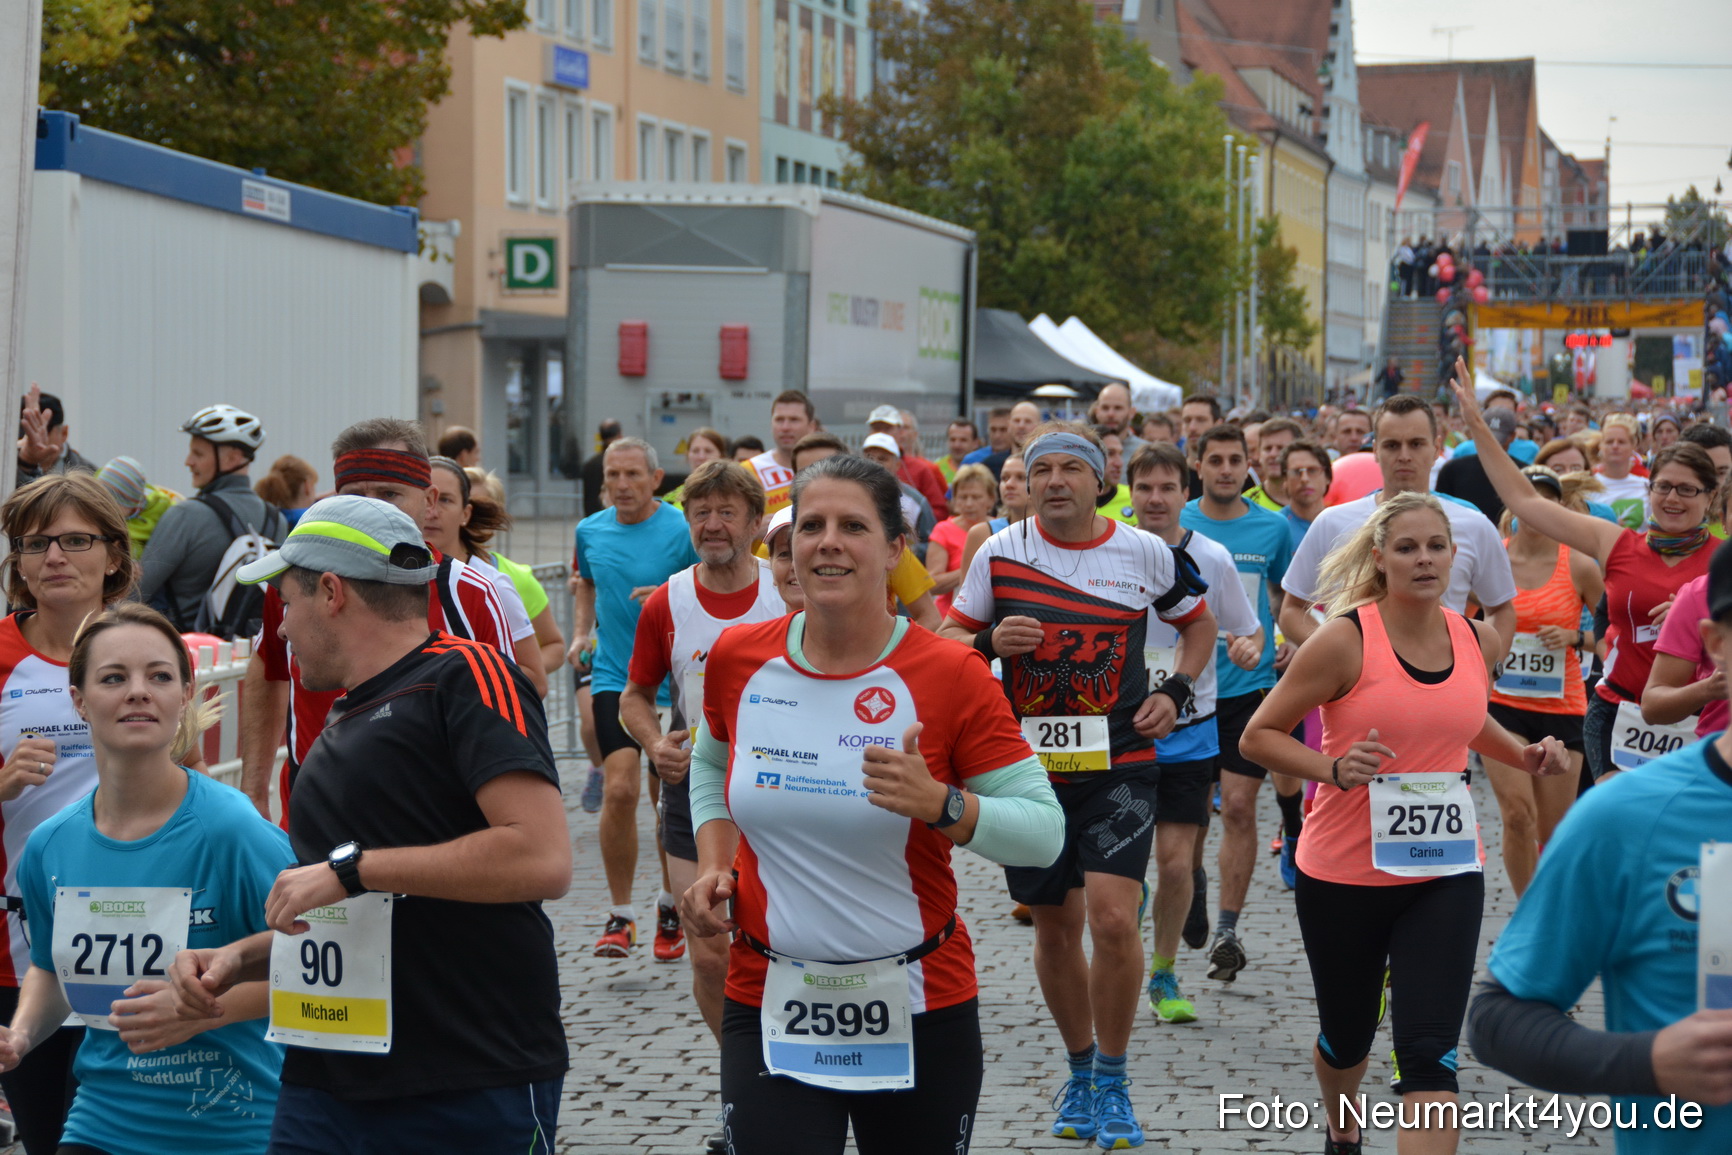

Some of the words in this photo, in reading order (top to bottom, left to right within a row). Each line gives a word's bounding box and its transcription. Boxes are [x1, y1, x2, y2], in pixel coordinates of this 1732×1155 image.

[513, 244, 551, 284] D
[1234, 553, 1266, 563] BOCK
[1088, 579, 1138, 591] NEUMARKT
[1505, 652, 1555, 673] 2159
[1519, 678, 1537, 687] Julia
[838, 734, 895, 750] KOPPE
[1038, 722, 1082, 747] 281
[1623, 727, 1684, 756] 2040
[752, 746, 790, 758] MICHAEL
[792, 750, 819, 760] KLEIN
[785, 775, 847, 787] Raiffeisenbank
[1412, 782, 1446, 791] BOCK
[784, 784, 827, 795] Neumarkt
[1387, 803, 1463, 836] 2578
[1103, 836, 1133, 859] UNDER
[1409, 846, 1444, 858] Carina
[102, 901, 146, 912] BOCK
[71, 933, 165, 976] 2712
[1712, 955, 1720, 966] D
[300, 939, 343, 987] 90
[816, 974, 867, 987] BOCK
[301, 1001, 349, 1022] Michael
[783, 1000, 890, 1037] 2599
[771, 1028, 777, 1036] D
[127, 1050, 221, 1069] Neumarkter
[814, 1051, 863, 1066] Annett
[132, 1067, 203, 1085] Stadtlauf
[191, 1109, 203, 1119] 17.
[227, 1069, 242, 1086] 2017
